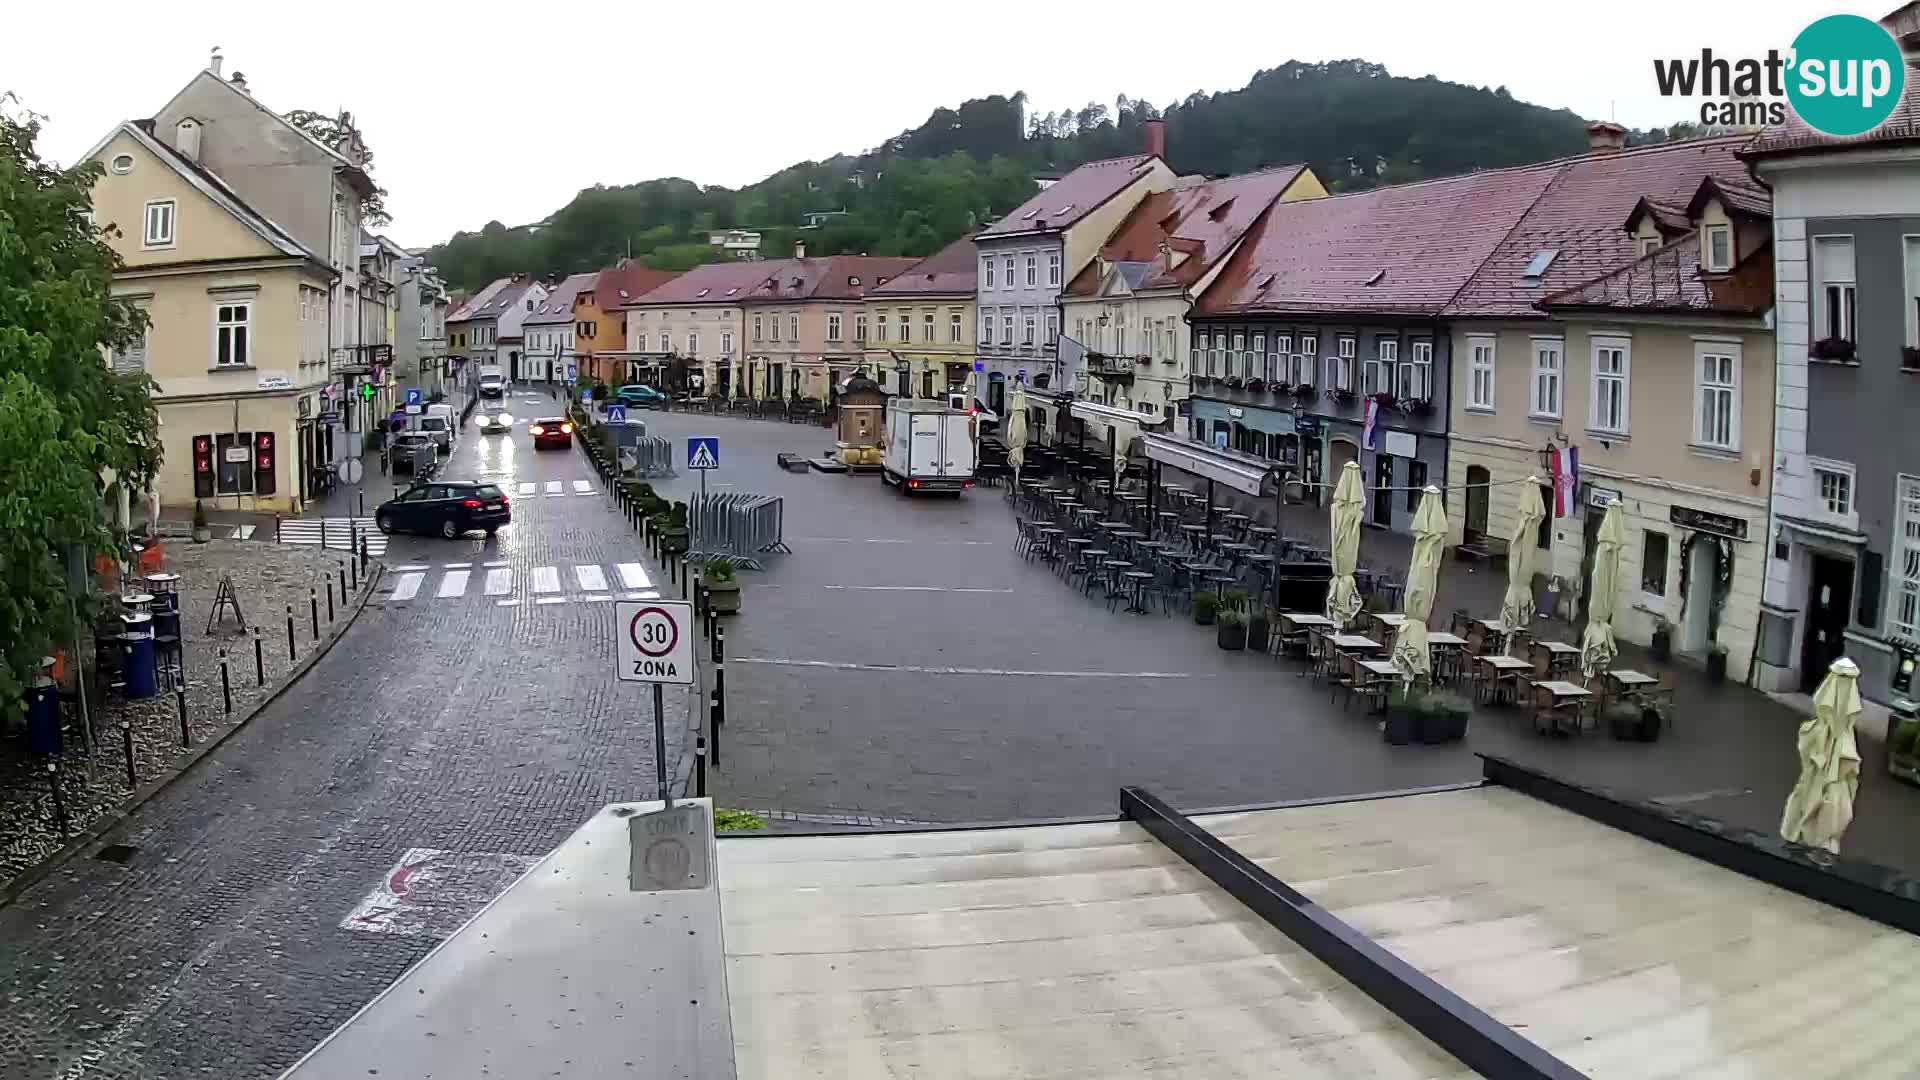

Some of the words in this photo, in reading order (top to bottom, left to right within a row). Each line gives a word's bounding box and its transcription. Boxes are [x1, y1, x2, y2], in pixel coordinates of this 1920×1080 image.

[409, 391, 418, 403] P
[642, 622, 667, 644] 30
[632, 660, 678, 677] ZONA
